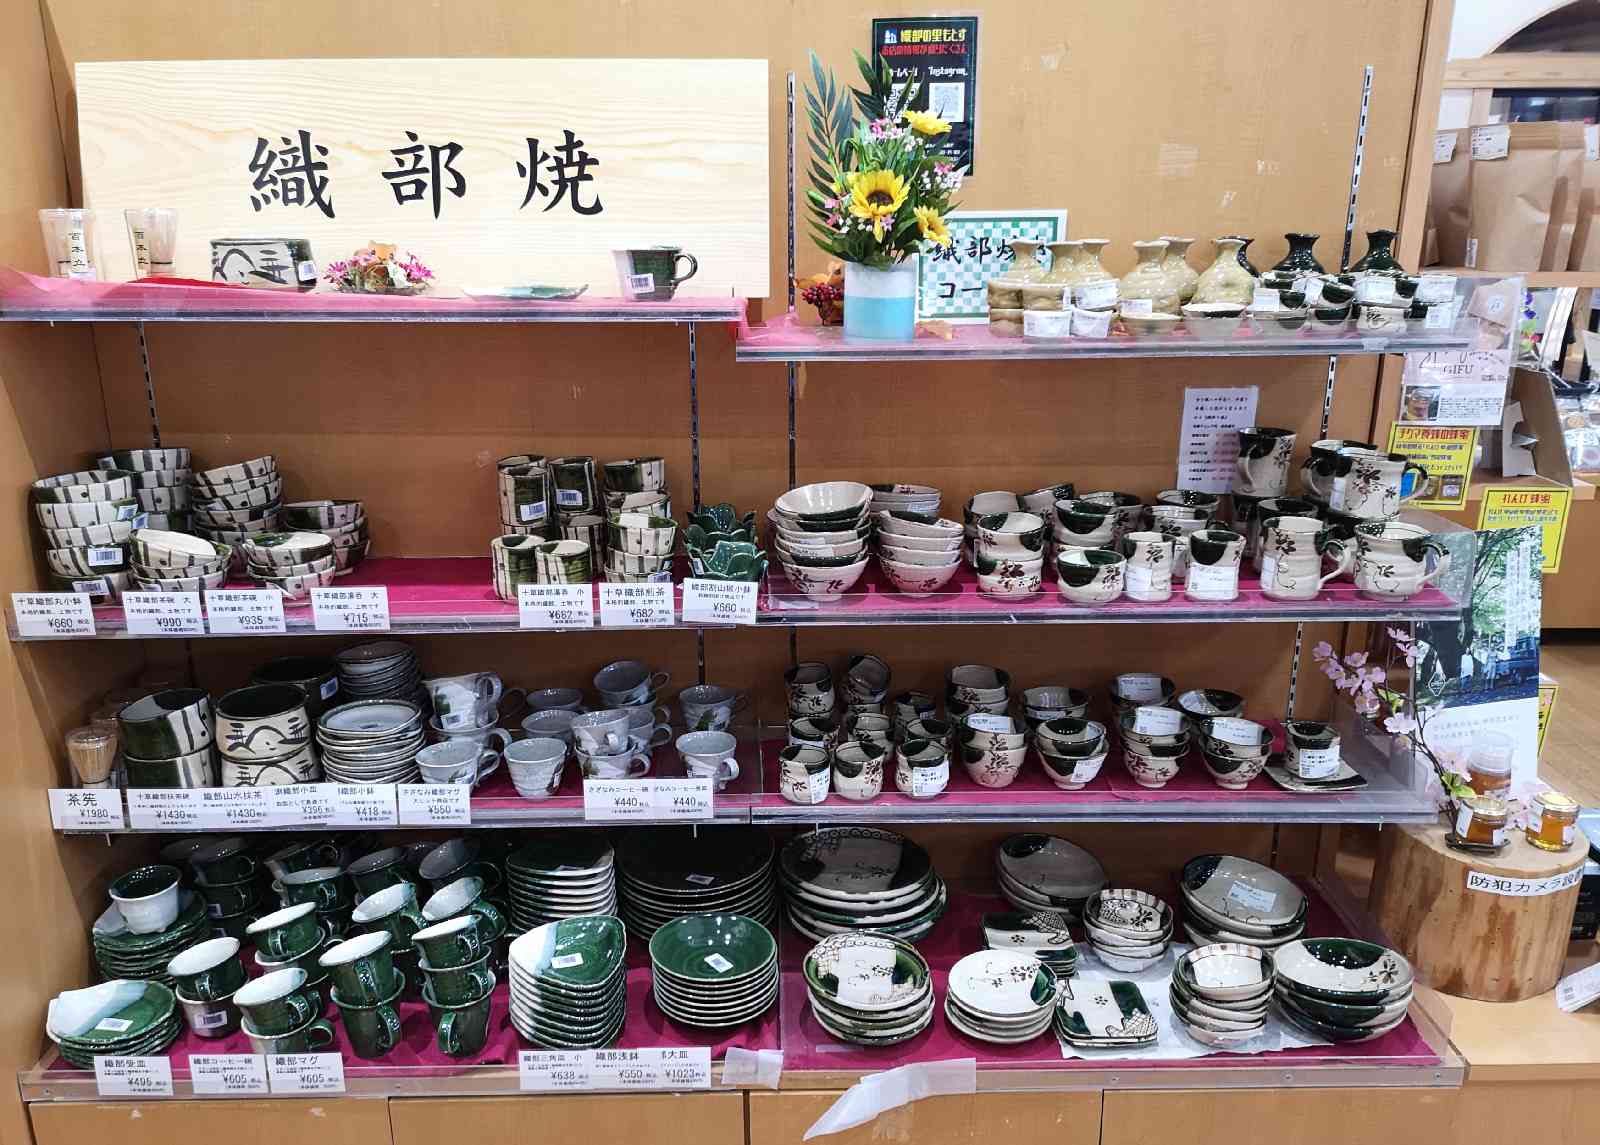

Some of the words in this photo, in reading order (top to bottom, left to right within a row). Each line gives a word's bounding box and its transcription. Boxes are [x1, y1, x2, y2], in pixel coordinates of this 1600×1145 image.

[248, 130, 604, 220] 織部焼
[343, 613, 369, 623] ¥715
[629, 608, 654, 618] ¥682
[48, 618, 73, 628] ¥660
[156, 617, 182, 627] ¥990
[238, 615, 264, 625] ¥935
[66, 792, 98, 807] 茶筅
[614, 797, 638, 807] ¥440
[673, 796, 696, 807] ¥440
[79, 808, 109, 818] ¥1980
[156, 810, 186, 820] ¥1430
[226, 808, 256, 818] ¥1430
[356, 806, 379, 817] ¥418
[275, 1055, 319, 1066] 織部マグ
[299, 1073, 325, 1084] ¥605
[551, 1071, 576, 1080] ¥638
[618, 1069, 643, 1079] ¥550
[665, 1068, 695, 1079] ¥1023
